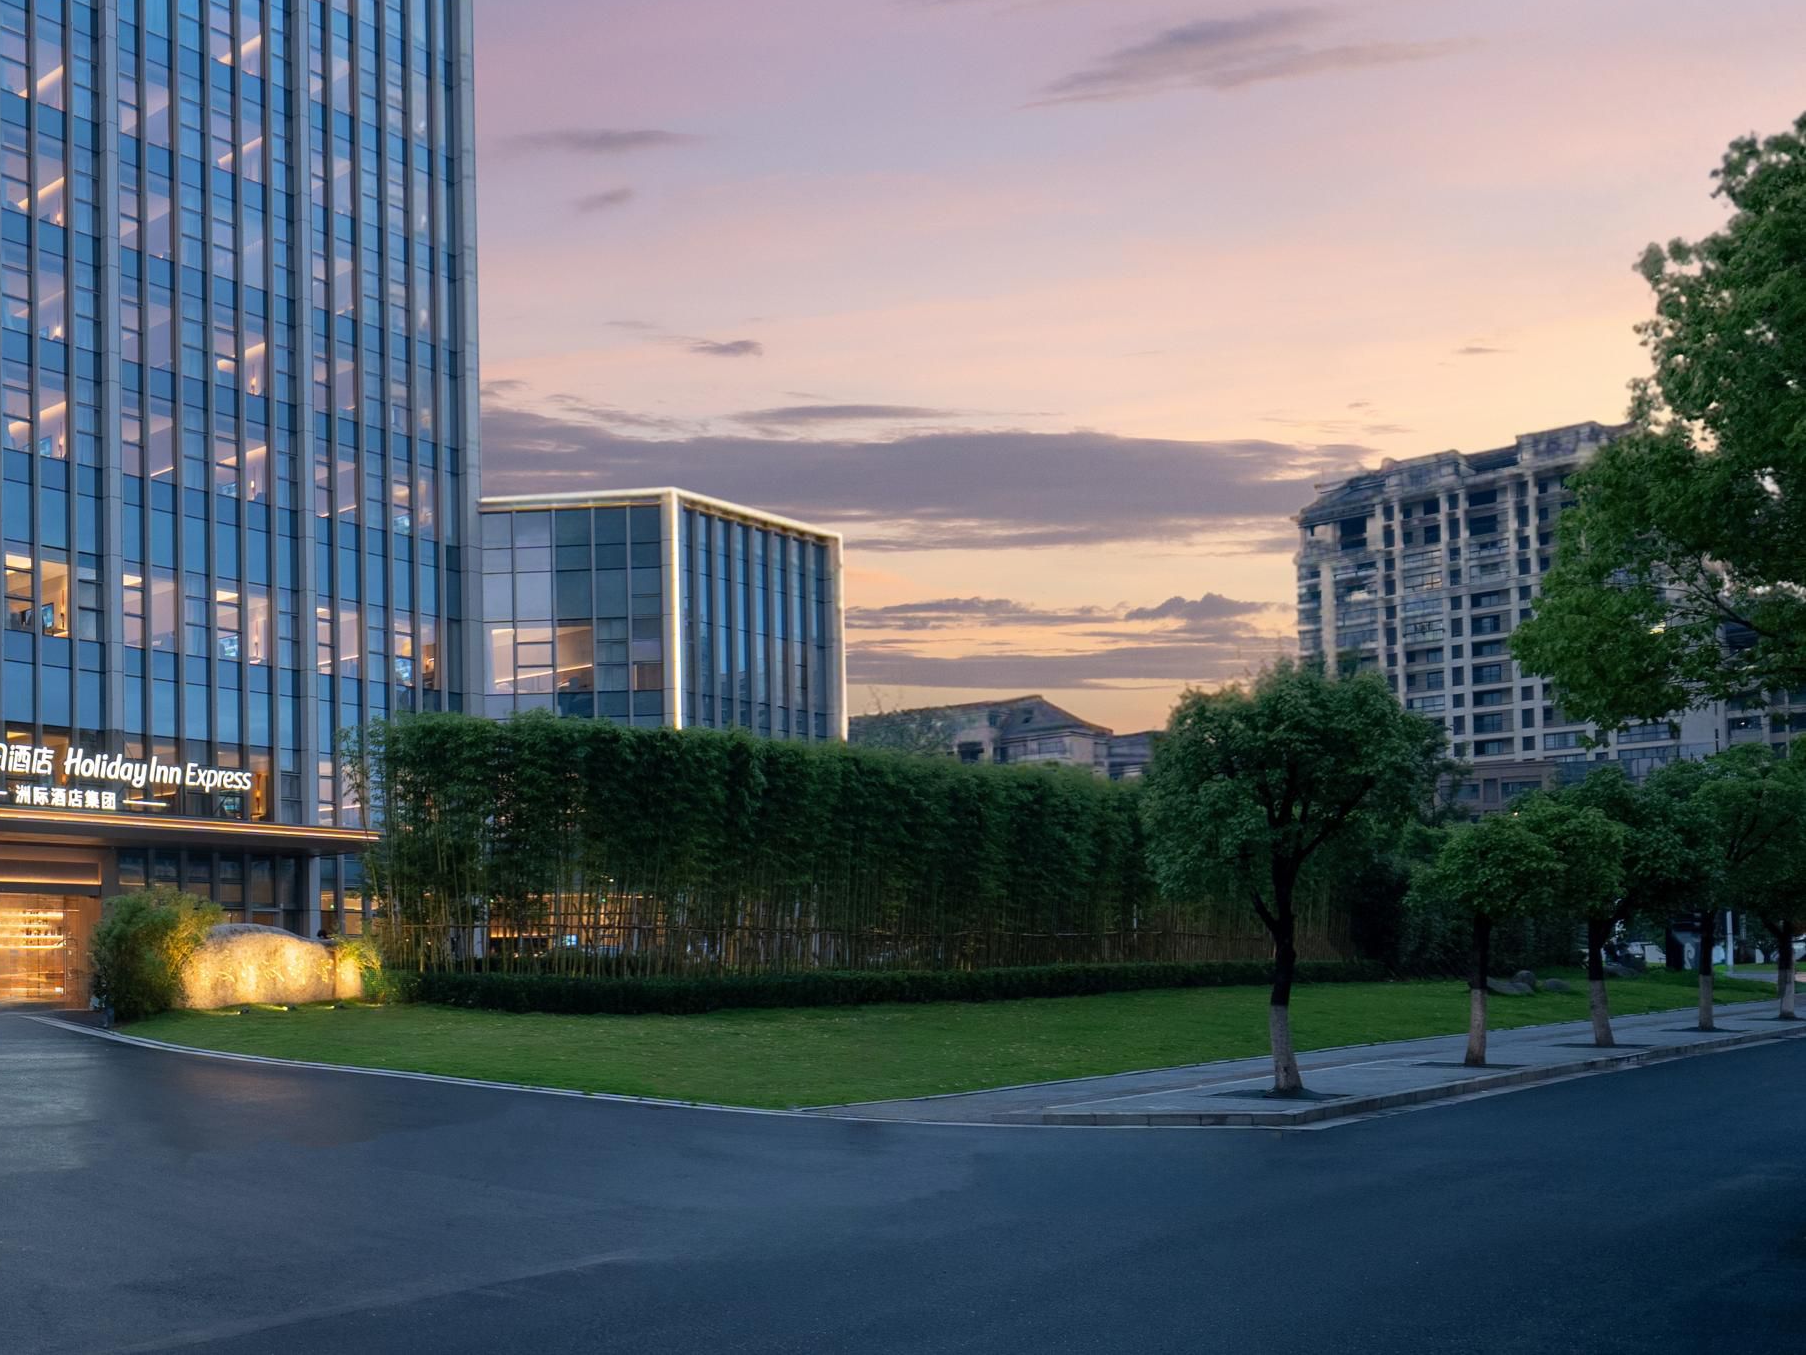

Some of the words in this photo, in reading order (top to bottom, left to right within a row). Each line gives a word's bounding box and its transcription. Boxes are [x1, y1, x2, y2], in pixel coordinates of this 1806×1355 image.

[63, 747, 148, 789] Holiday
[149, 756, 181, 785] Inn
[185, 762, 252, 791] Express
[15, 783, 117, 811] 洲际酒店集团
